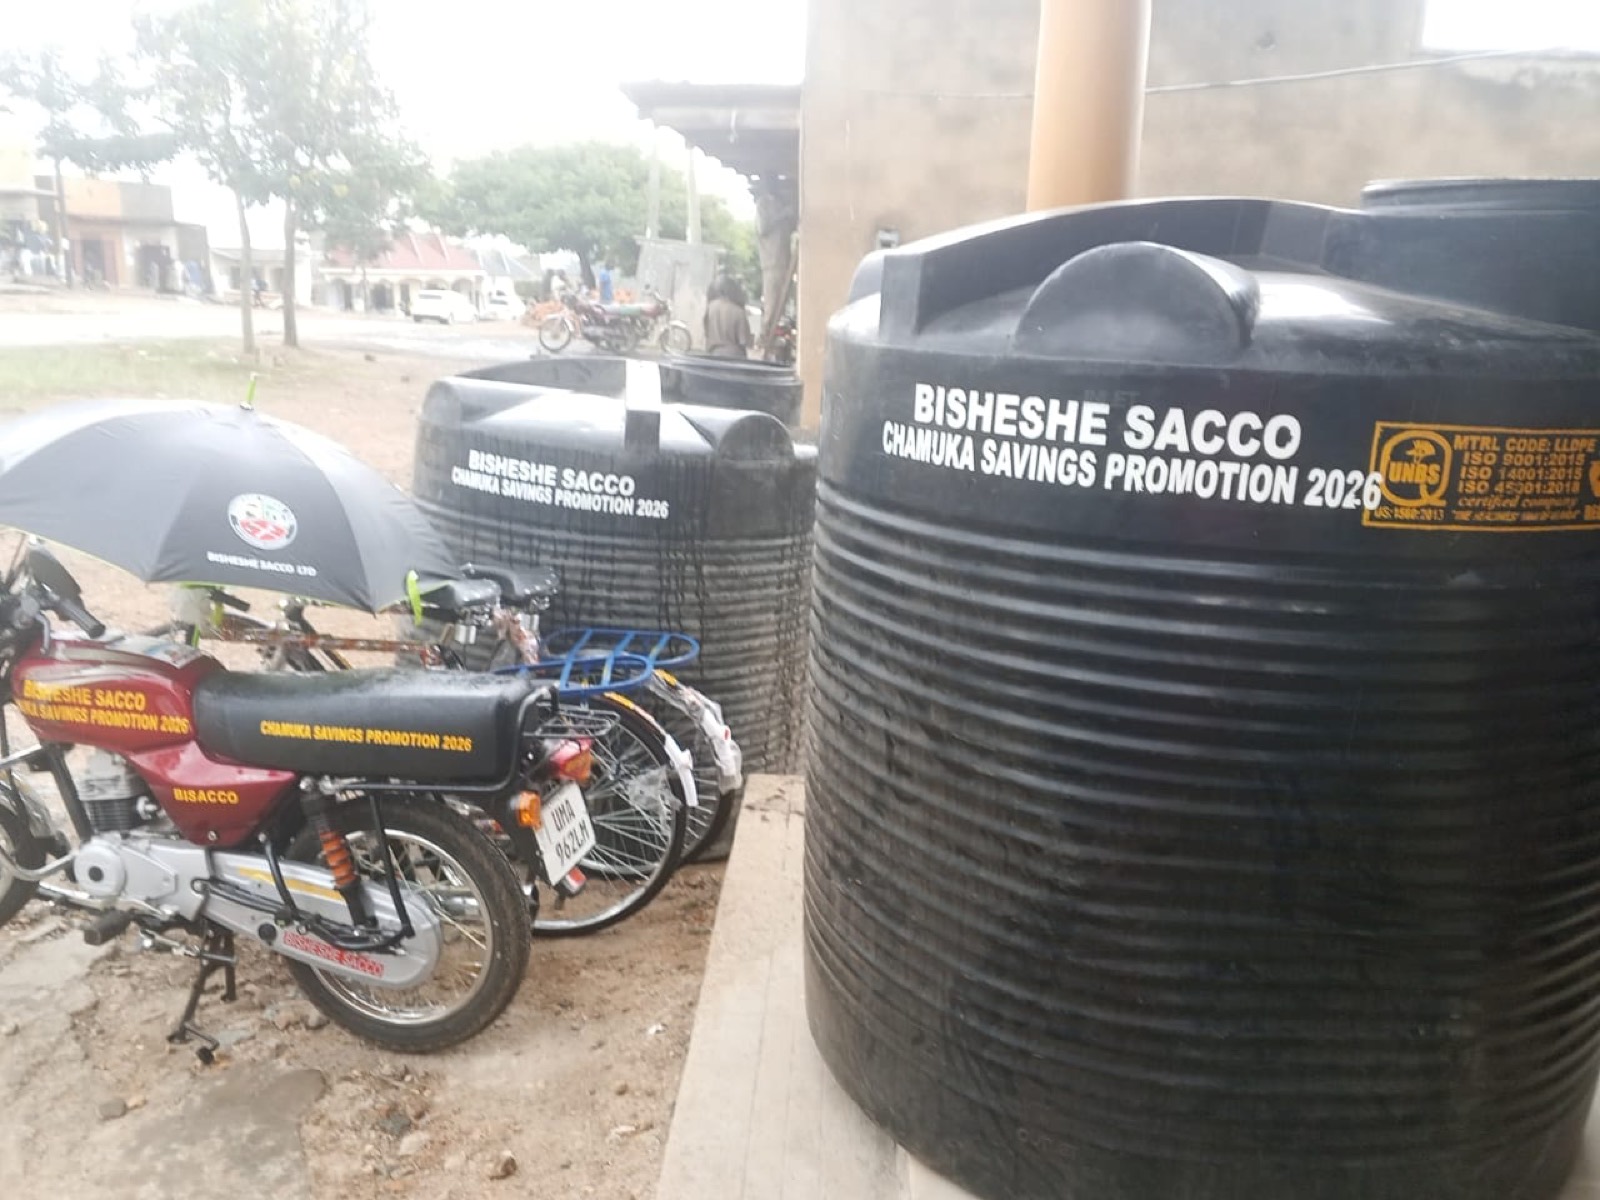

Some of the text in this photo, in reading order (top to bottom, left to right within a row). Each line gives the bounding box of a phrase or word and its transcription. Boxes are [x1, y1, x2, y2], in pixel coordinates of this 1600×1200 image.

[914, 383, 1301, 460] BISHESHE SACCO
[1454, 435, 1499, 451] MTRL
[882, 420, 1382, 510] CHAMUKA SAVINGS PROMOTION 2026
[1463, 452, 1586, 466] ISO 9001:2015
[469, 449, 635, 496] BISHESHE SACCO
[1389, 462, 1441, 485] UNBS
[1459, 466, 1583, 481] ISO 14001:2015
[451, 466, 669, 519] CHAMUKA SAVINGS PROMOTION 2026
[1458, 480, 1489, 494] ISO
[259, 559, 295, 574] SACCO
[296, 565, 317, 577] LTD
[95, 689, 146, 711] SACCO
[39, 702, 88, 722] SAVINGS
[90, 709, 158, 731] PROMOTION
[160, 717, 190, 734] 2026
[260, 719, 473, 752] CHAMUKA SAVINGS PROMOTION 2026
[173, 787, 239, 804] BISACCO
[551, 799, 576, 832] UMA
